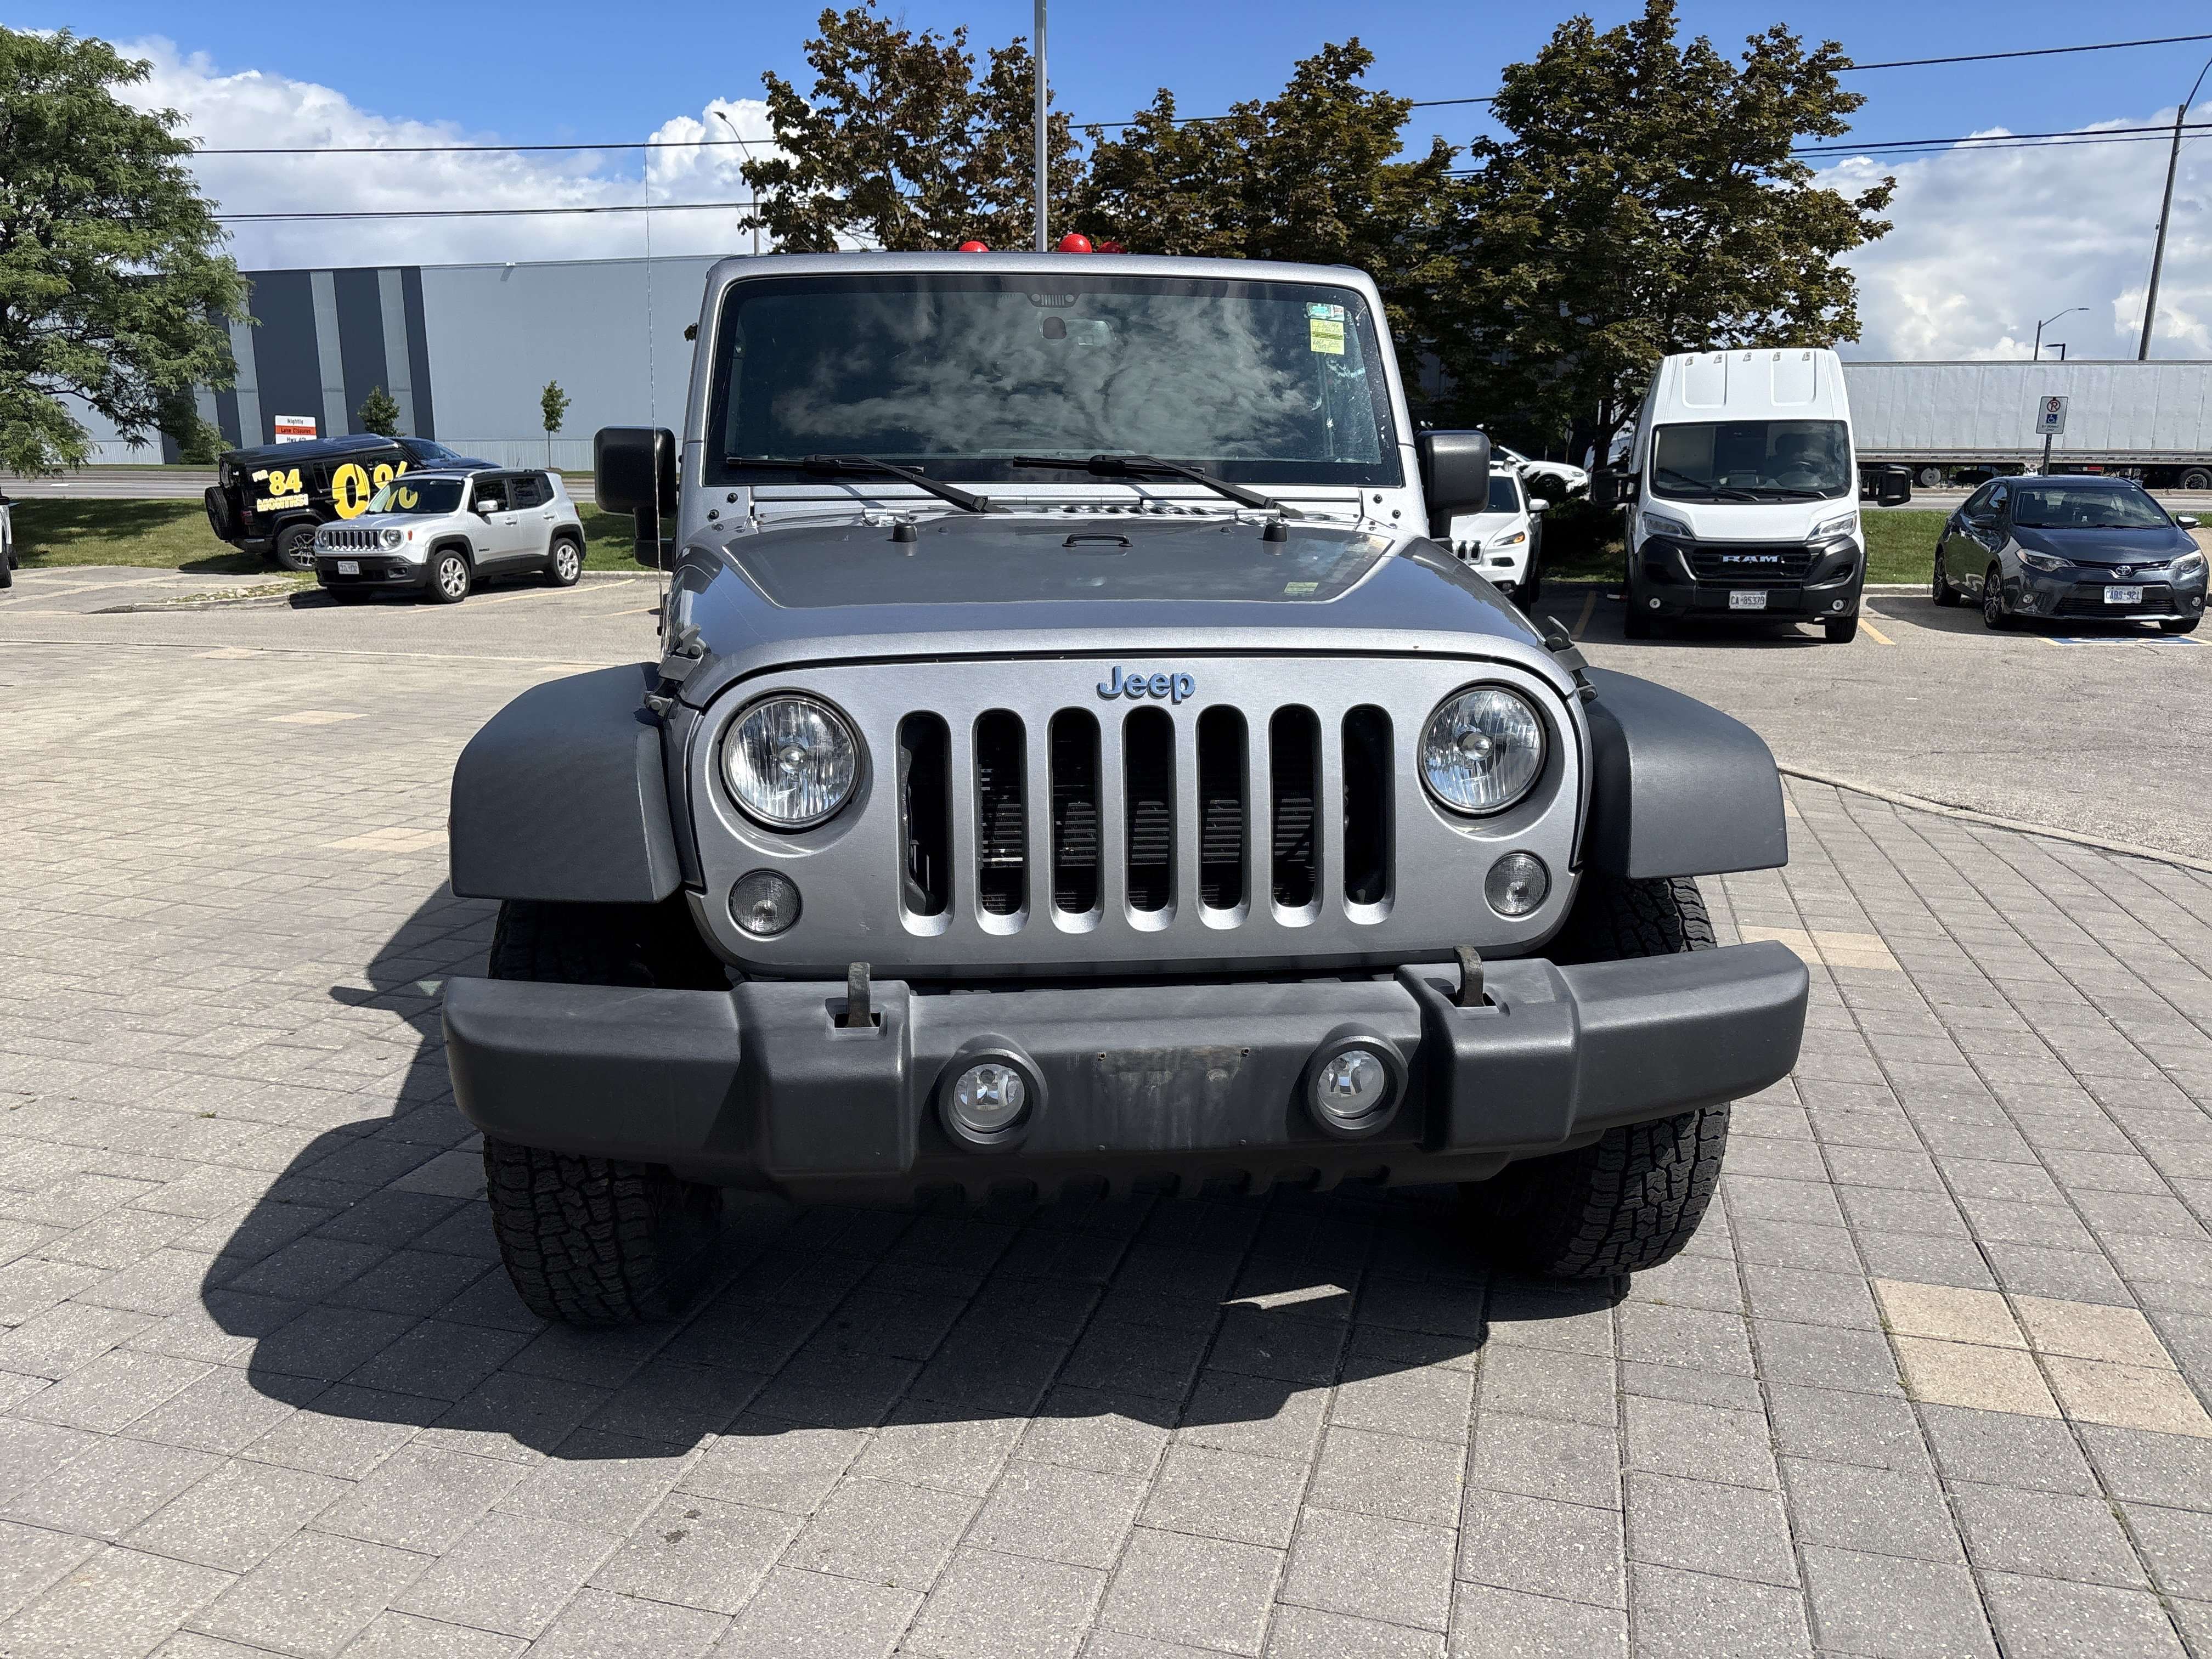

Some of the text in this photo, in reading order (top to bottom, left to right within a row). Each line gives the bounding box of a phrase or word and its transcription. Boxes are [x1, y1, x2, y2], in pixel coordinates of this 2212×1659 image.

[252, 469, 303, 495] FOR 84
[256, 494, 308, 512] MONTHS!
[1097, 666, 1195, 705] Jeep
